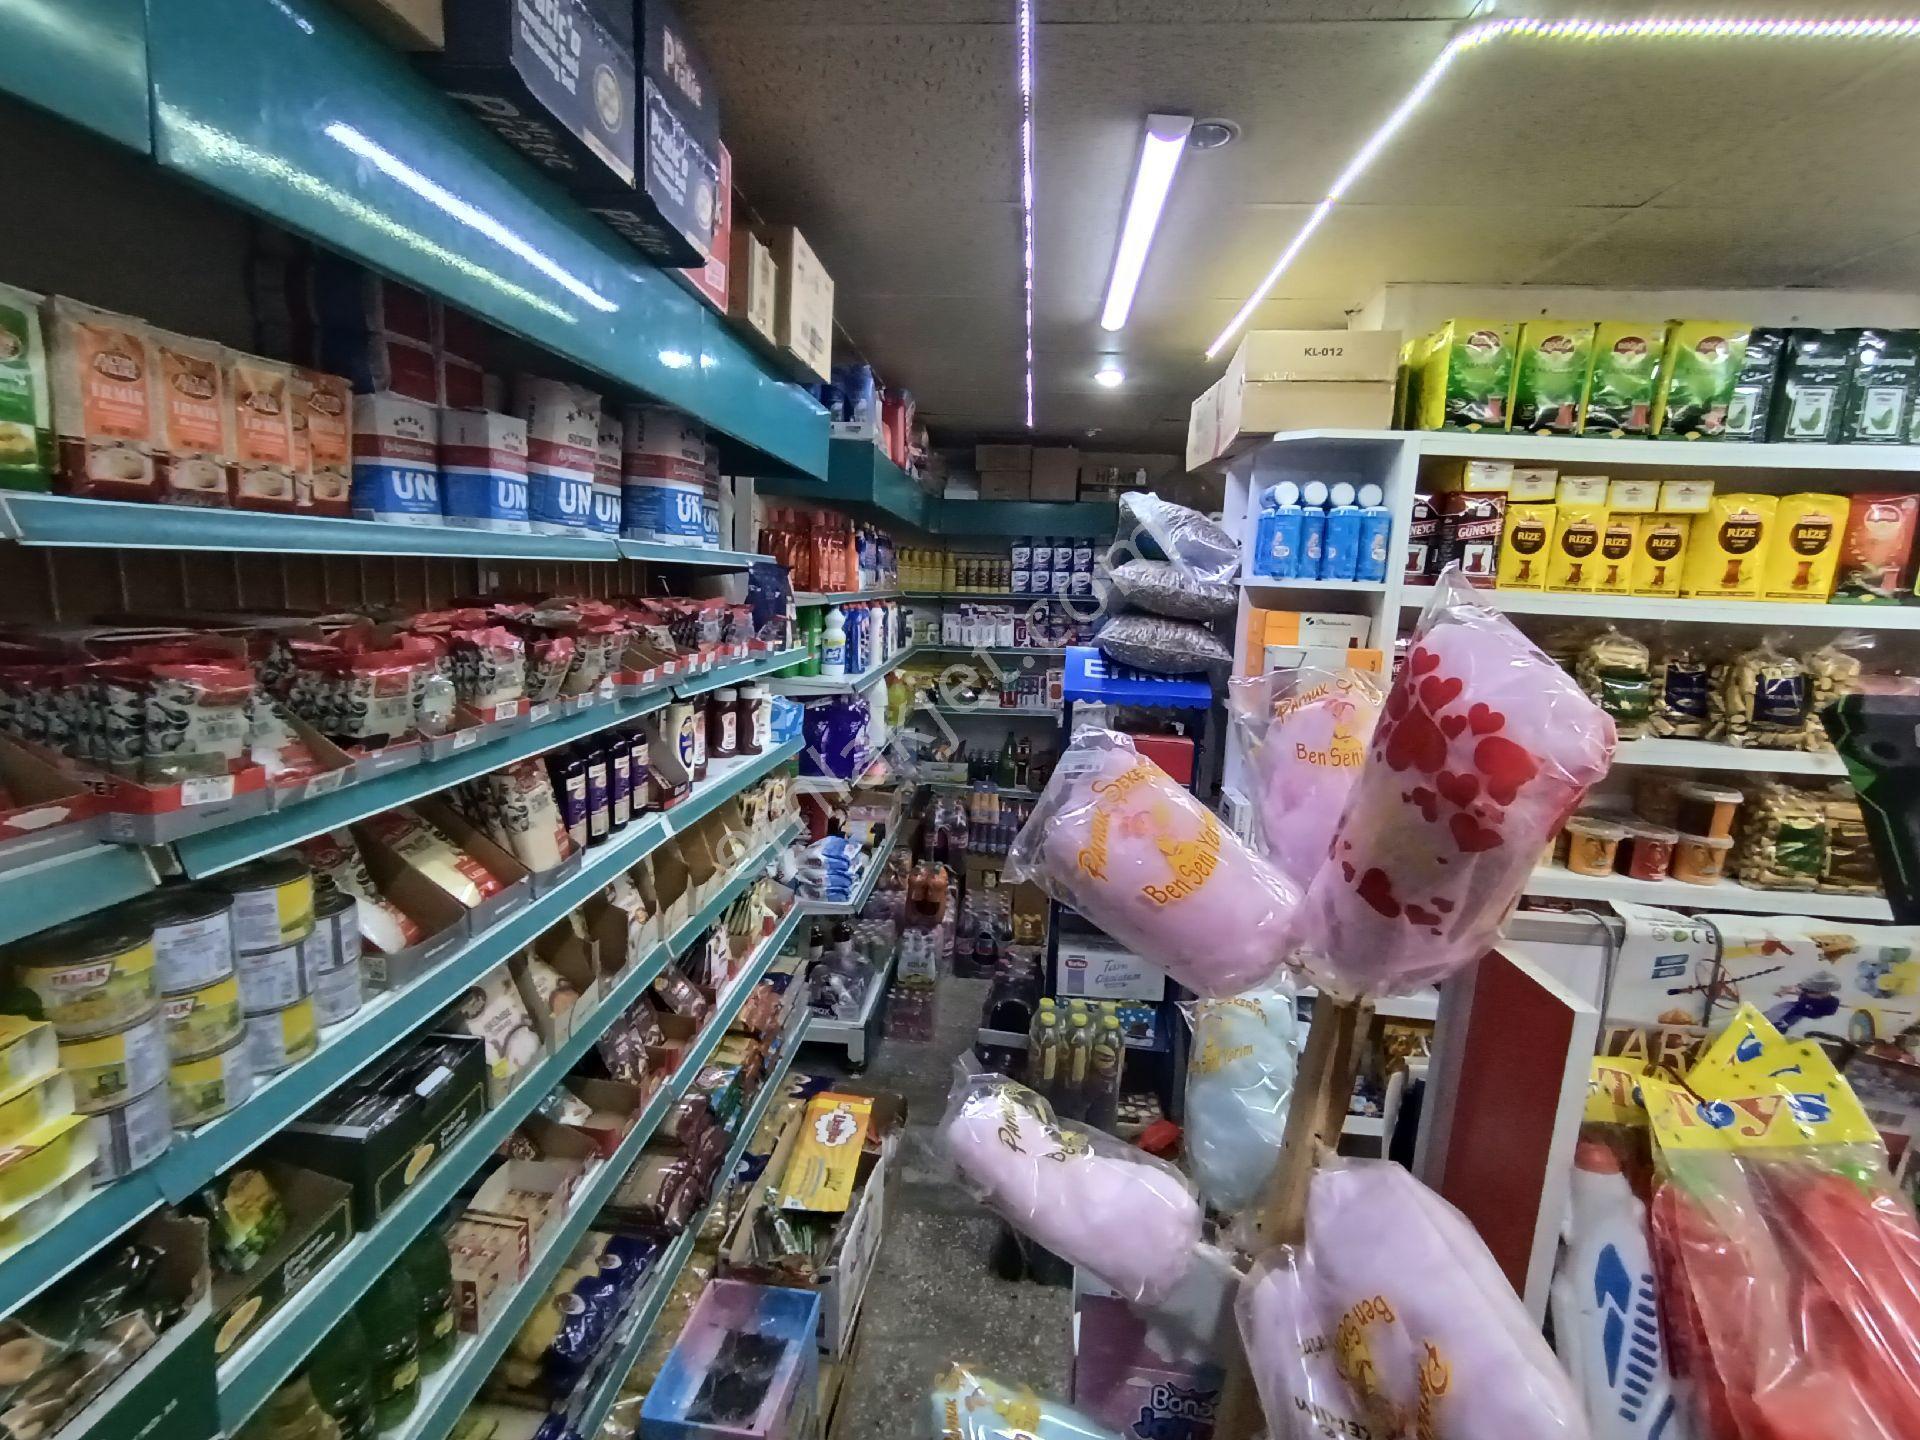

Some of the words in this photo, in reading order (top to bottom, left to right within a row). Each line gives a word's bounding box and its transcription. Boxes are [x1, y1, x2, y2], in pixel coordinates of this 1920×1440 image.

[1304, 347, 1344, 357] KL-012
[391, 470, 438, 502] UN
[498, 481, 527, 510] UN
[558, 481, 592, 516] UN
[1458, 521, 1502, 538] GÜNEYCE
[1296, 742, 1327, 767] Ben
[1143, 876, 1193, 905] Ben
